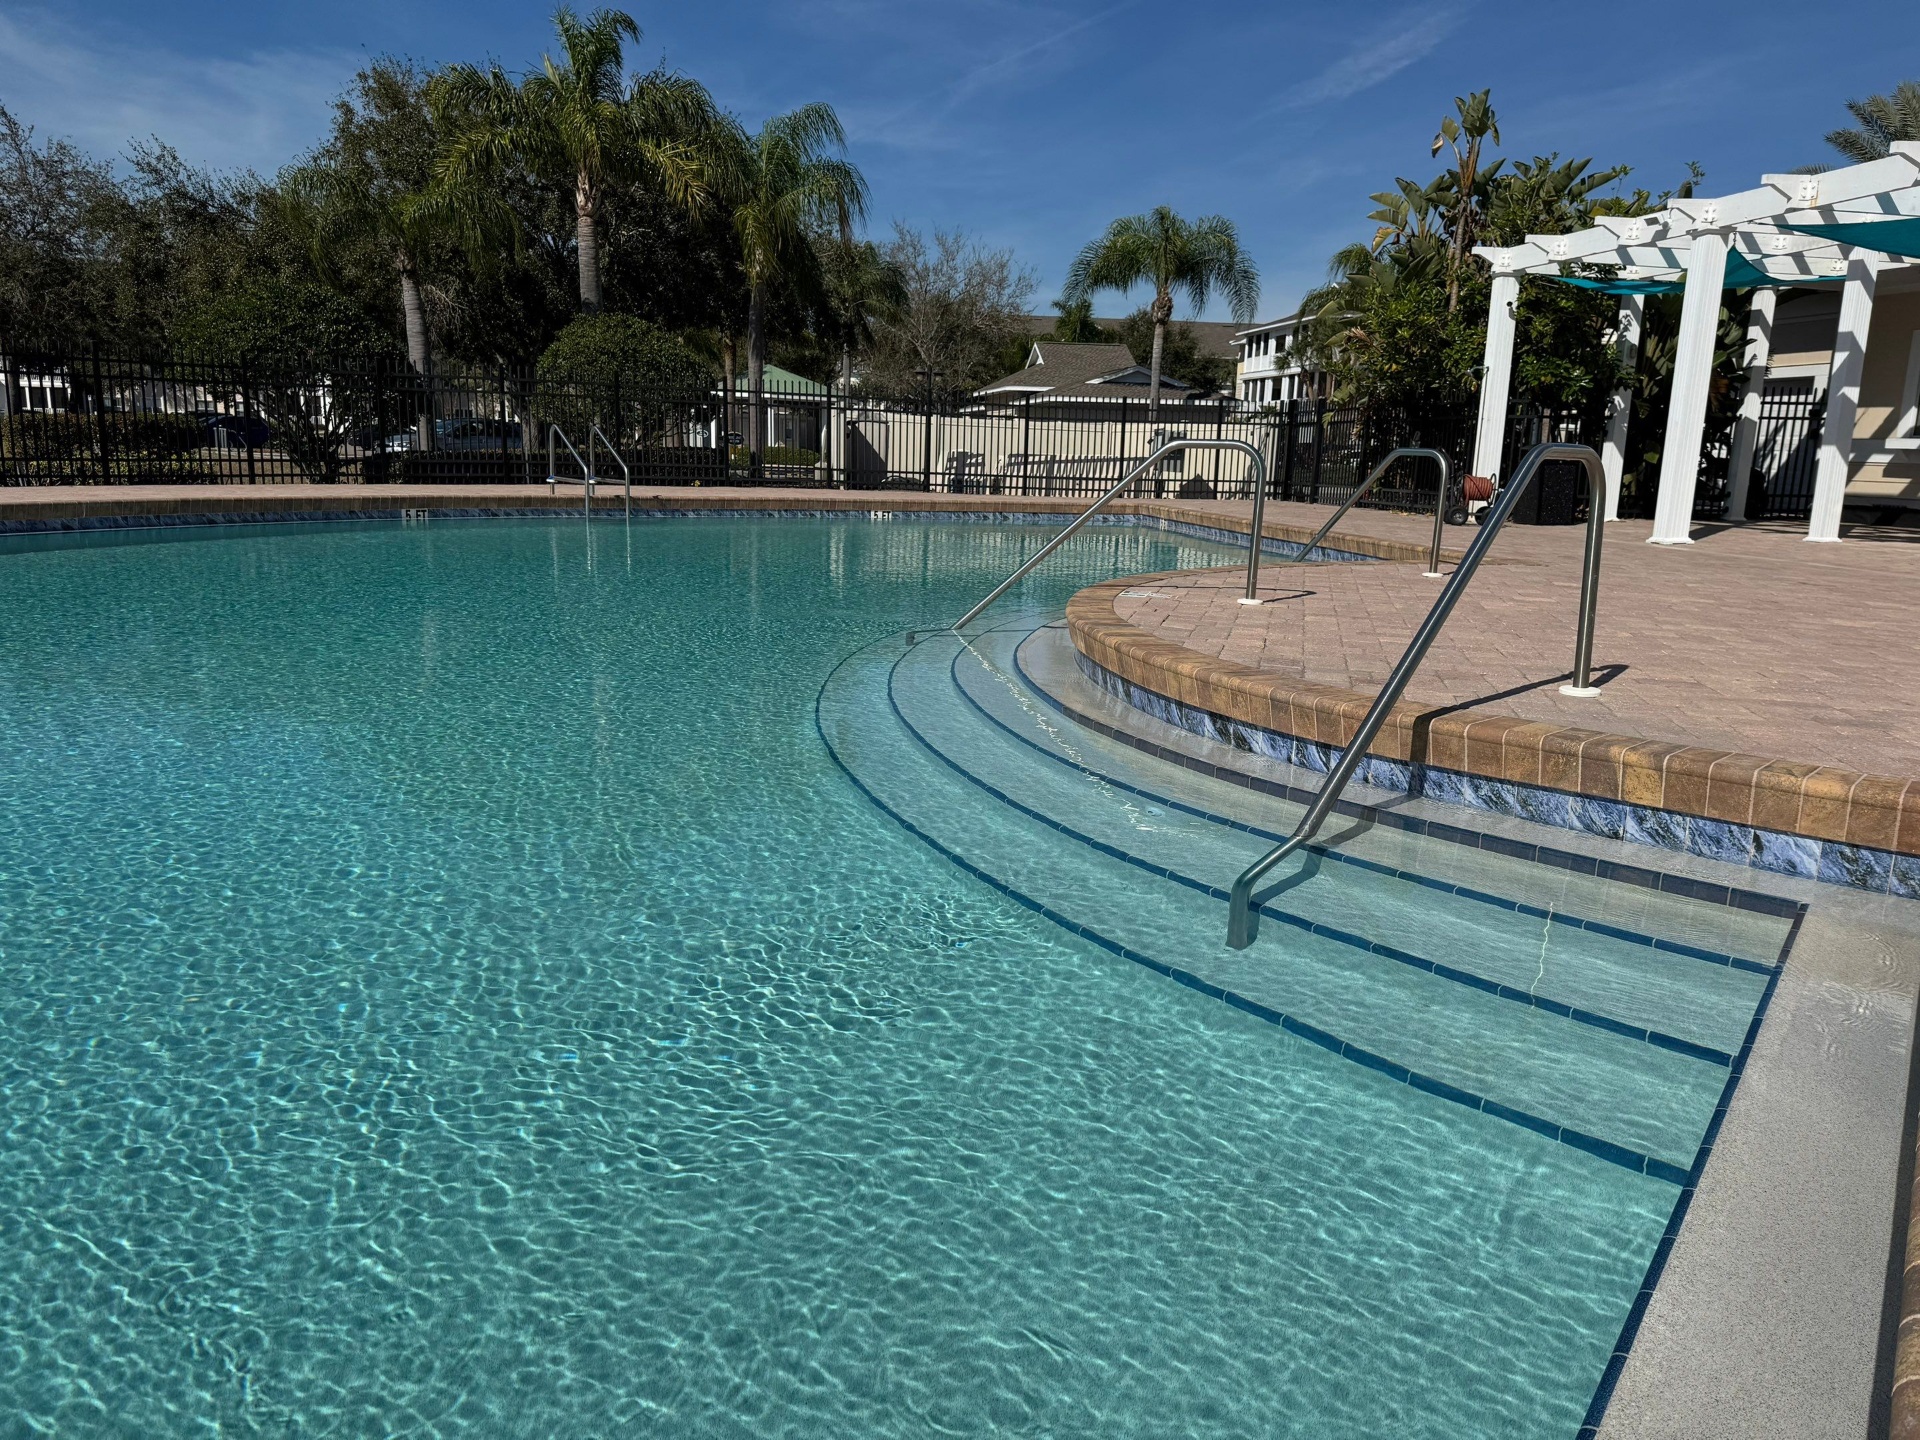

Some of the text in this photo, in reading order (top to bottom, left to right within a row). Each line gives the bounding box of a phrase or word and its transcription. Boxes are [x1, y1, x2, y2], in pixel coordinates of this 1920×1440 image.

[405, 509, 427, 520] 5 FT
[873, 510, 891, 520] 5 FT
